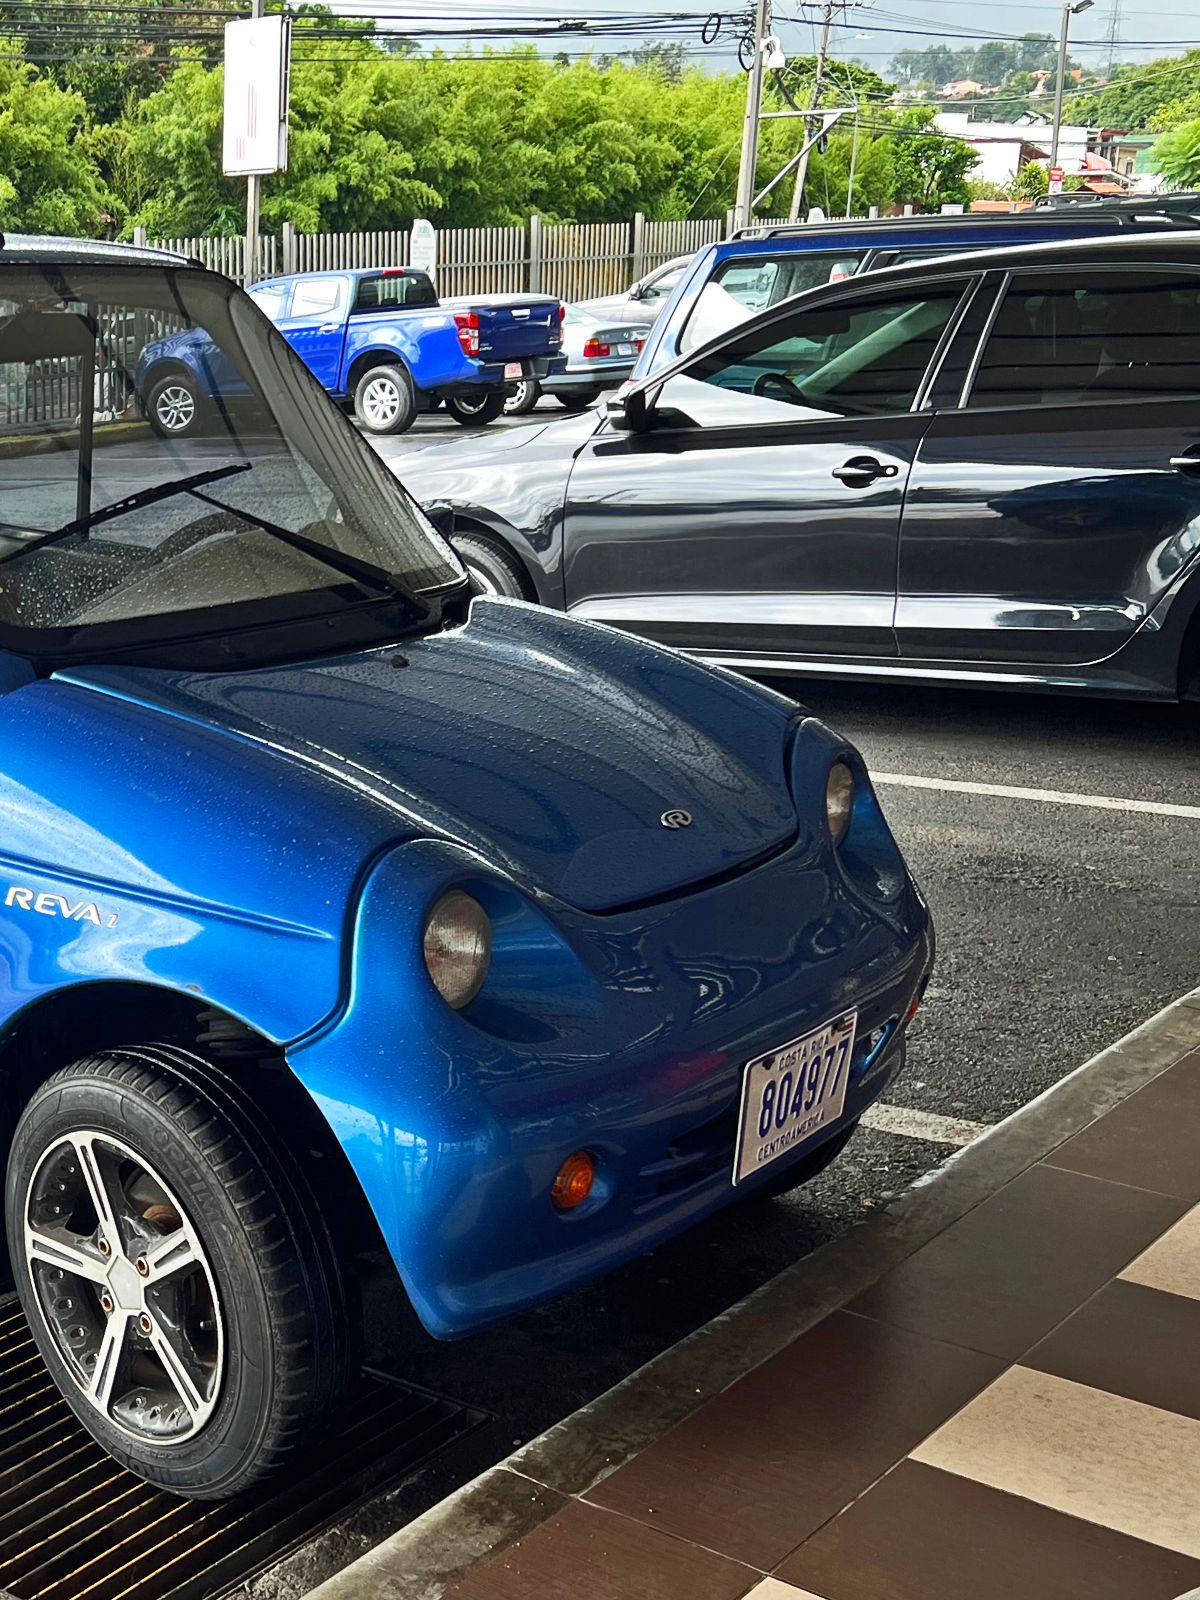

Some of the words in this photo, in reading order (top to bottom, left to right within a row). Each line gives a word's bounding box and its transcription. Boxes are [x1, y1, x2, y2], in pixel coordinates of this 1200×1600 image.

[4, 886, 102, 926] REVA
[779, 1044, 807, 1071] COSTA
[810, 1034, 830, 1054] RICA
[758, 1038, 850, 1138] 804977
[758, 1108, 825, 1162] CENTROAMERICA
